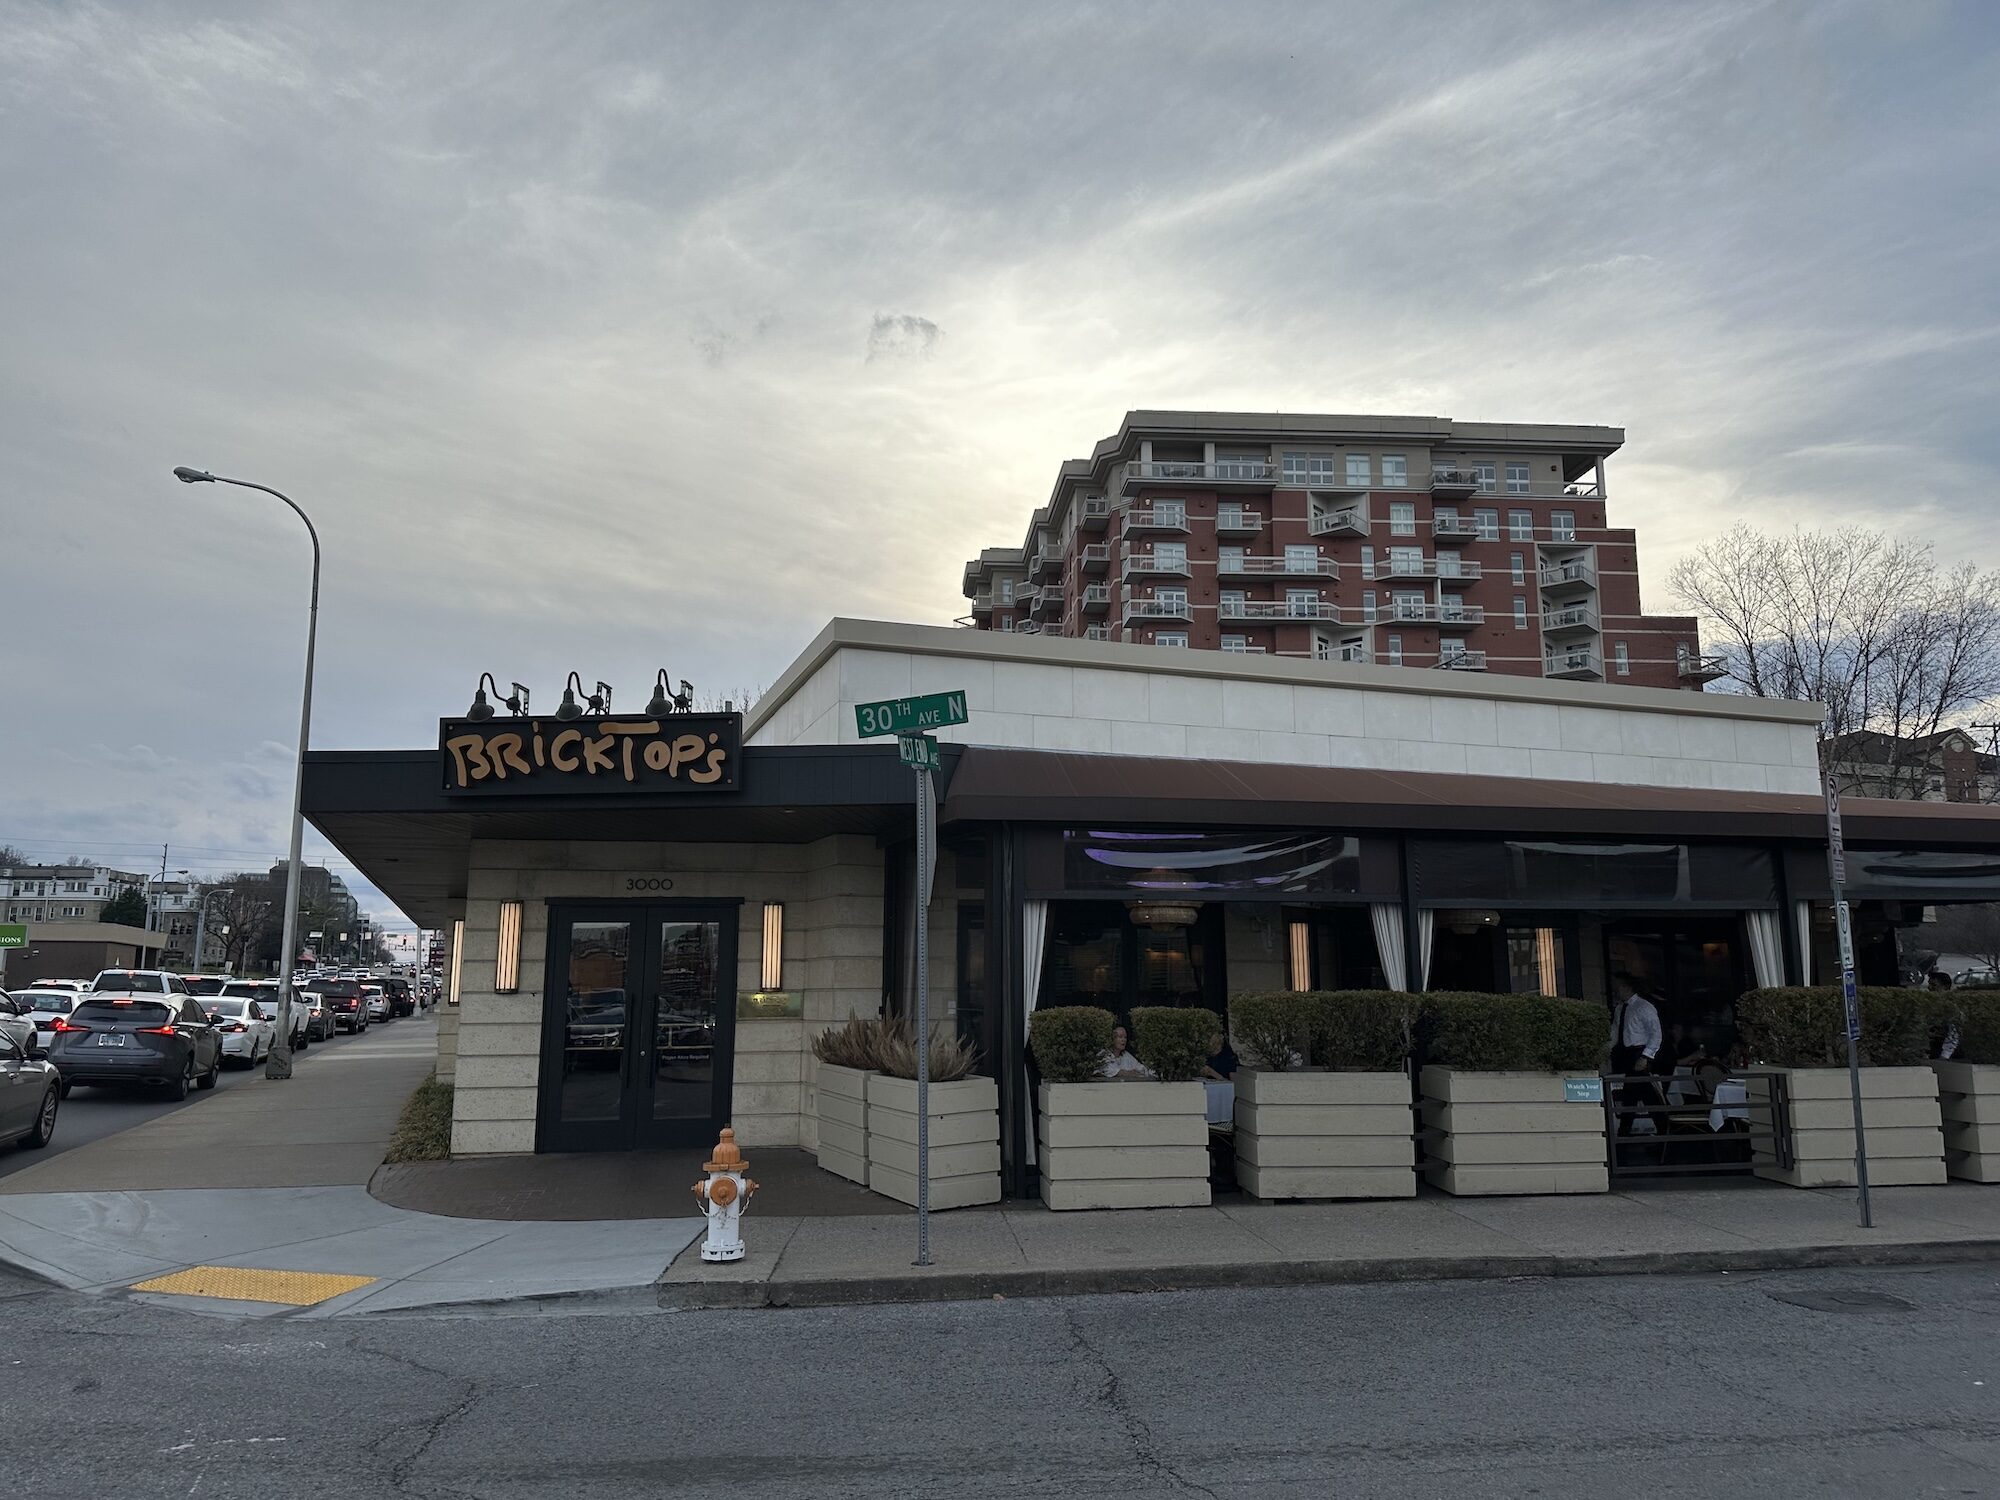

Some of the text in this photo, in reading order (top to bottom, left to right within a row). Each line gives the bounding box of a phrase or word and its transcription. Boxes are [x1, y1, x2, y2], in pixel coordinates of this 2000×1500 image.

[918, 709, 940, 725] AVE
[947, 695, 963, 720] N
[626, 878, 673, 891] 3000
[0, 936, 21, 944] IONS
